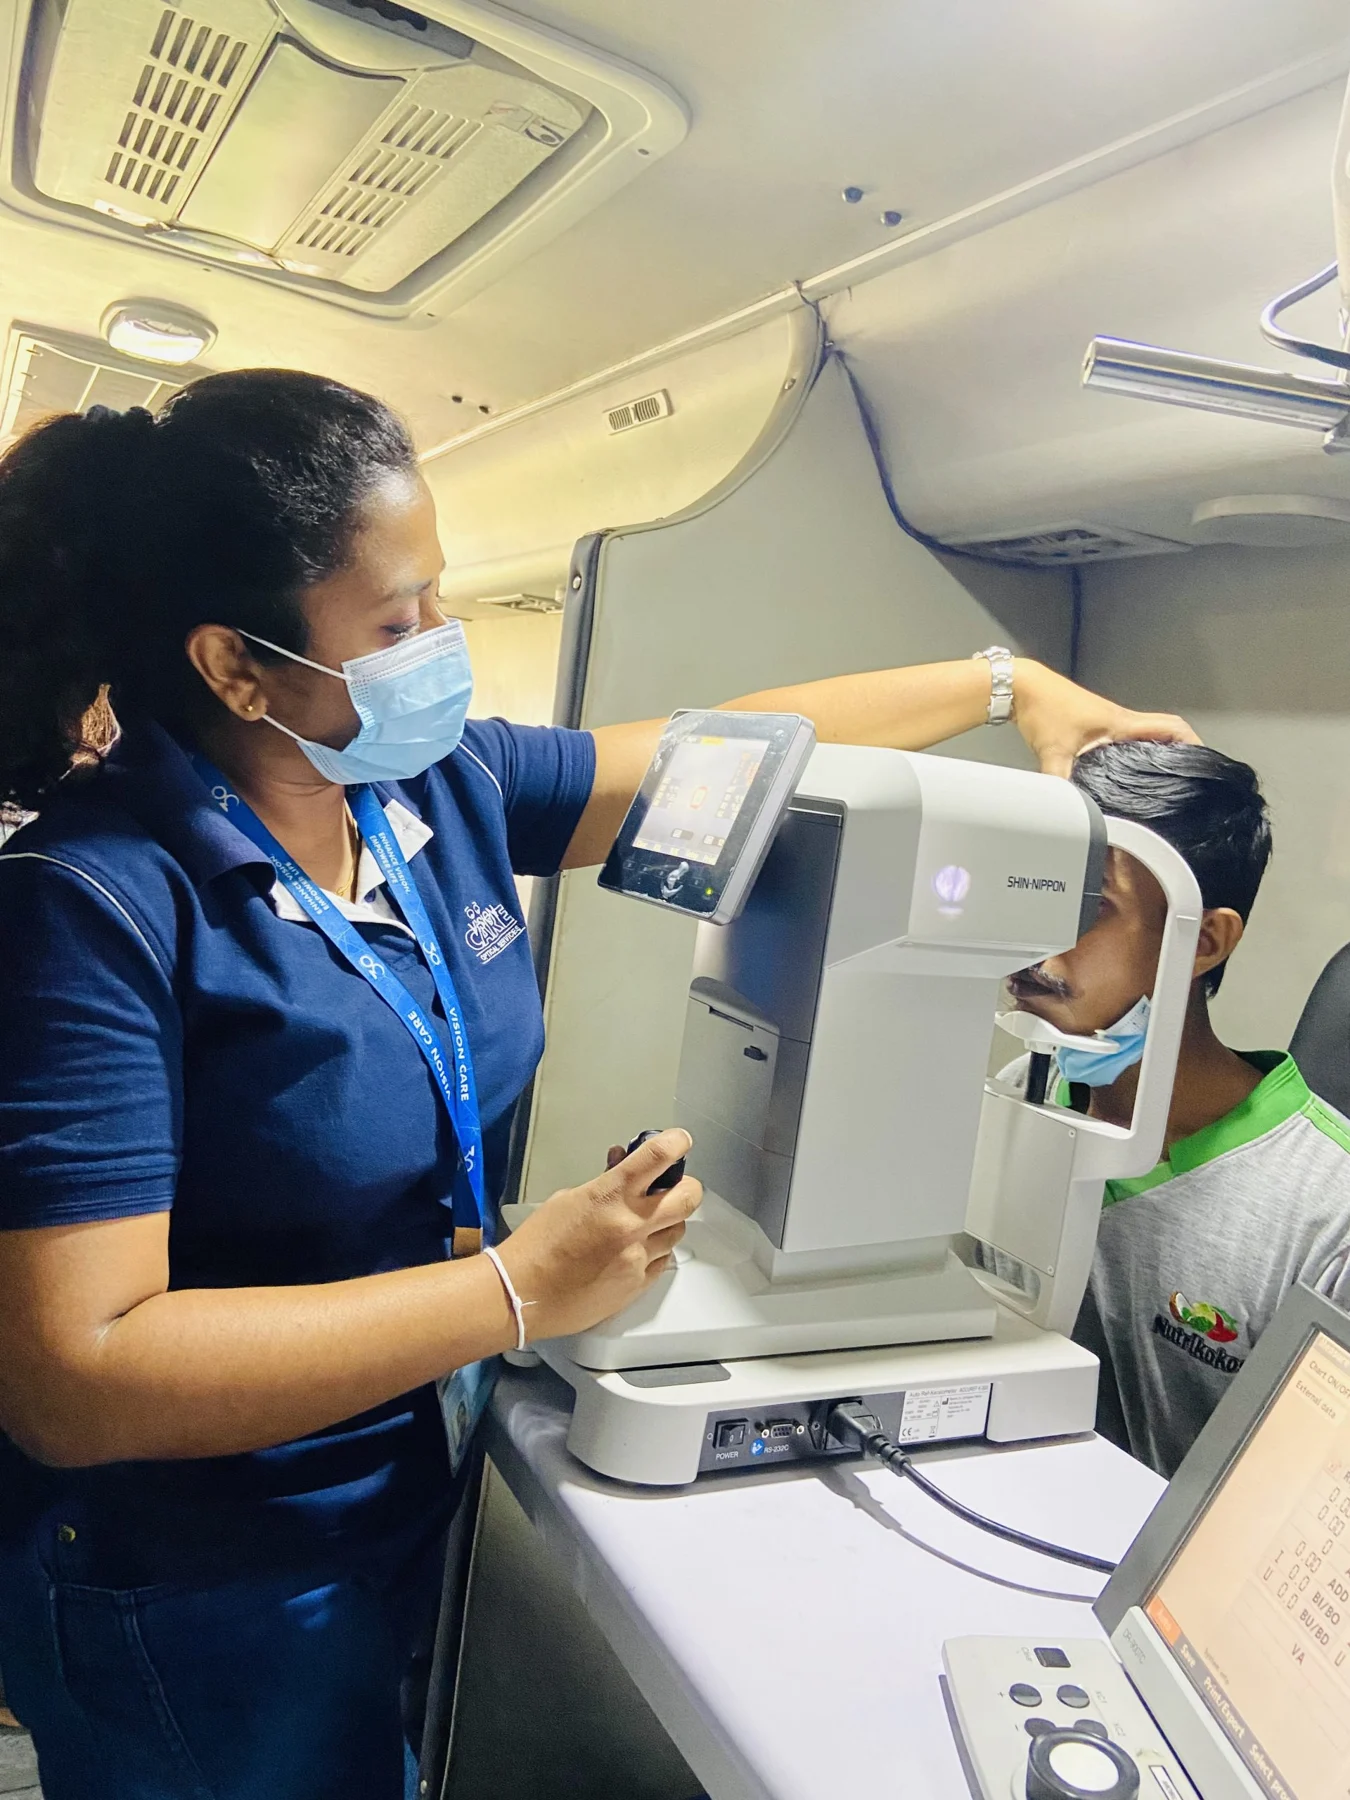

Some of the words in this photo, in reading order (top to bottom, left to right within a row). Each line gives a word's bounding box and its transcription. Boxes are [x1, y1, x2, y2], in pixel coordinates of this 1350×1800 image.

[369, 835, 390, 869] EMPOWER
[386, 868, 399, 885] LIFE
[378, 832, 397, 867] ENHANCE
[286, 862, 300, 876] LIFE
[1007, 876, 1066, 893] SHIN-NIPPON
[291, 881, 323, 915] ENHANCE
[299, 876, 330, 911] EMPOWER
[465, 904, 516, 951] CARE
[407, 1010, 433, 1045] CARE
[449, 1007, 465, 1059] VISION
[459, 1065, 470, 1101] CARE
[430, 1049, 451, 1100] VISION
[1309, 1360, 1327, 1379] Chart
[1295, 1380, 1321, 1406] External
[1320, 1402, 1337, 1419] data
[716, 1451, 739, 1460] POWER
[764, 1444, 789, 1454] RS-232C
[1328, 1578, 1349, 1602] ADD
[1312, 1591, 1341, 1625] BI/BO
[1300, 1608, 1330, 1646] BU/BD
[1291, 1643, 1305, 1665] VA
[1180, 1643, 1196, 1668] Save
[1204, 1676, 1245, 1739] Print/Export
[1249, 1744, 1274, 1781] Select
[1270, 1779, 1290, 1800] pro
